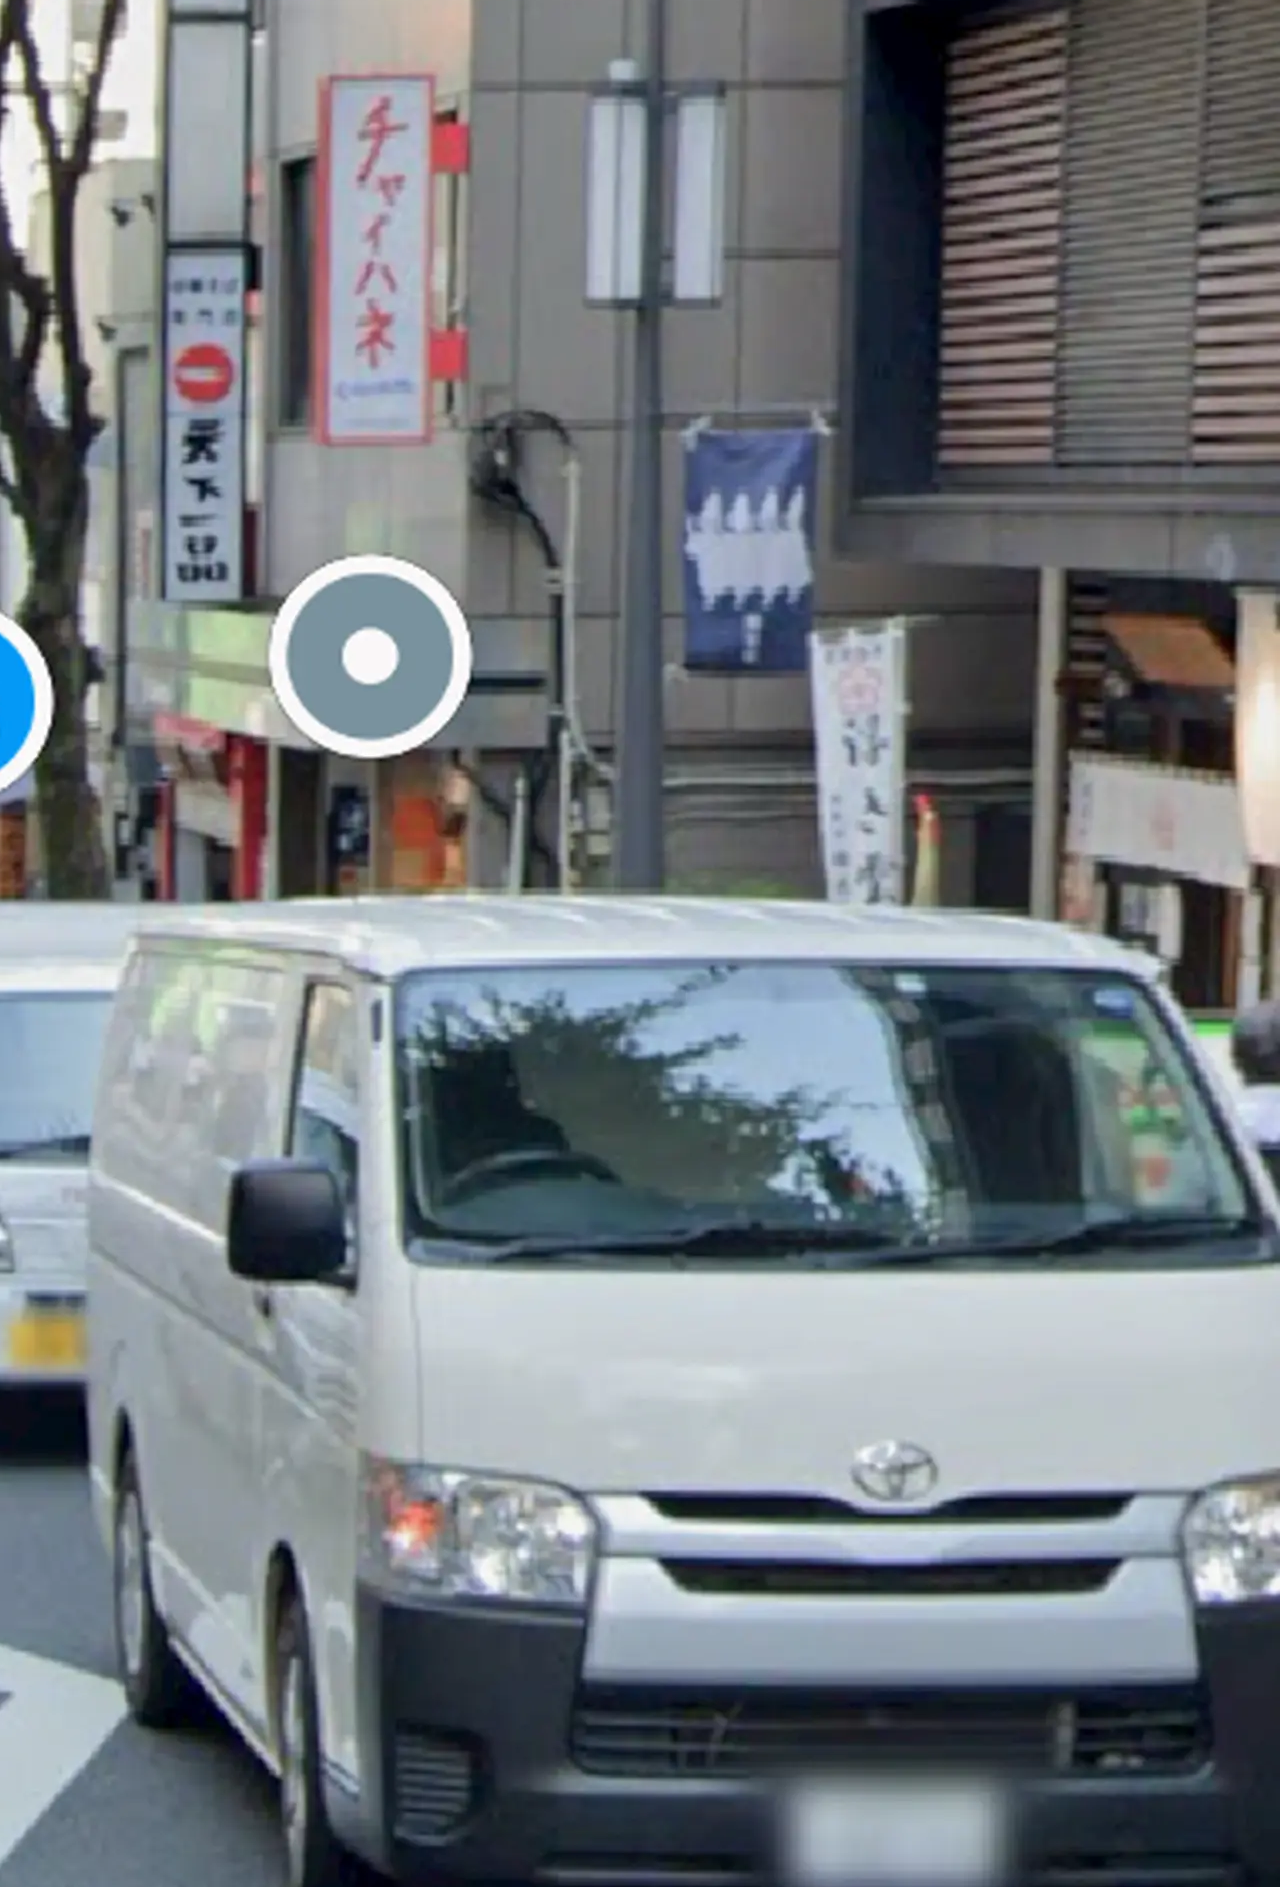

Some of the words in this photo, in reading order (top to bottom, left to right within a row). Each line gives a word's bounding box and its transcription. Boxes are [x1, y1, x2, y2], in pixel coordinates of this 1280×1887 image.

[354, 95, 407, 369] チャイハネ
[176, 417, 230, 585] 天下一品
